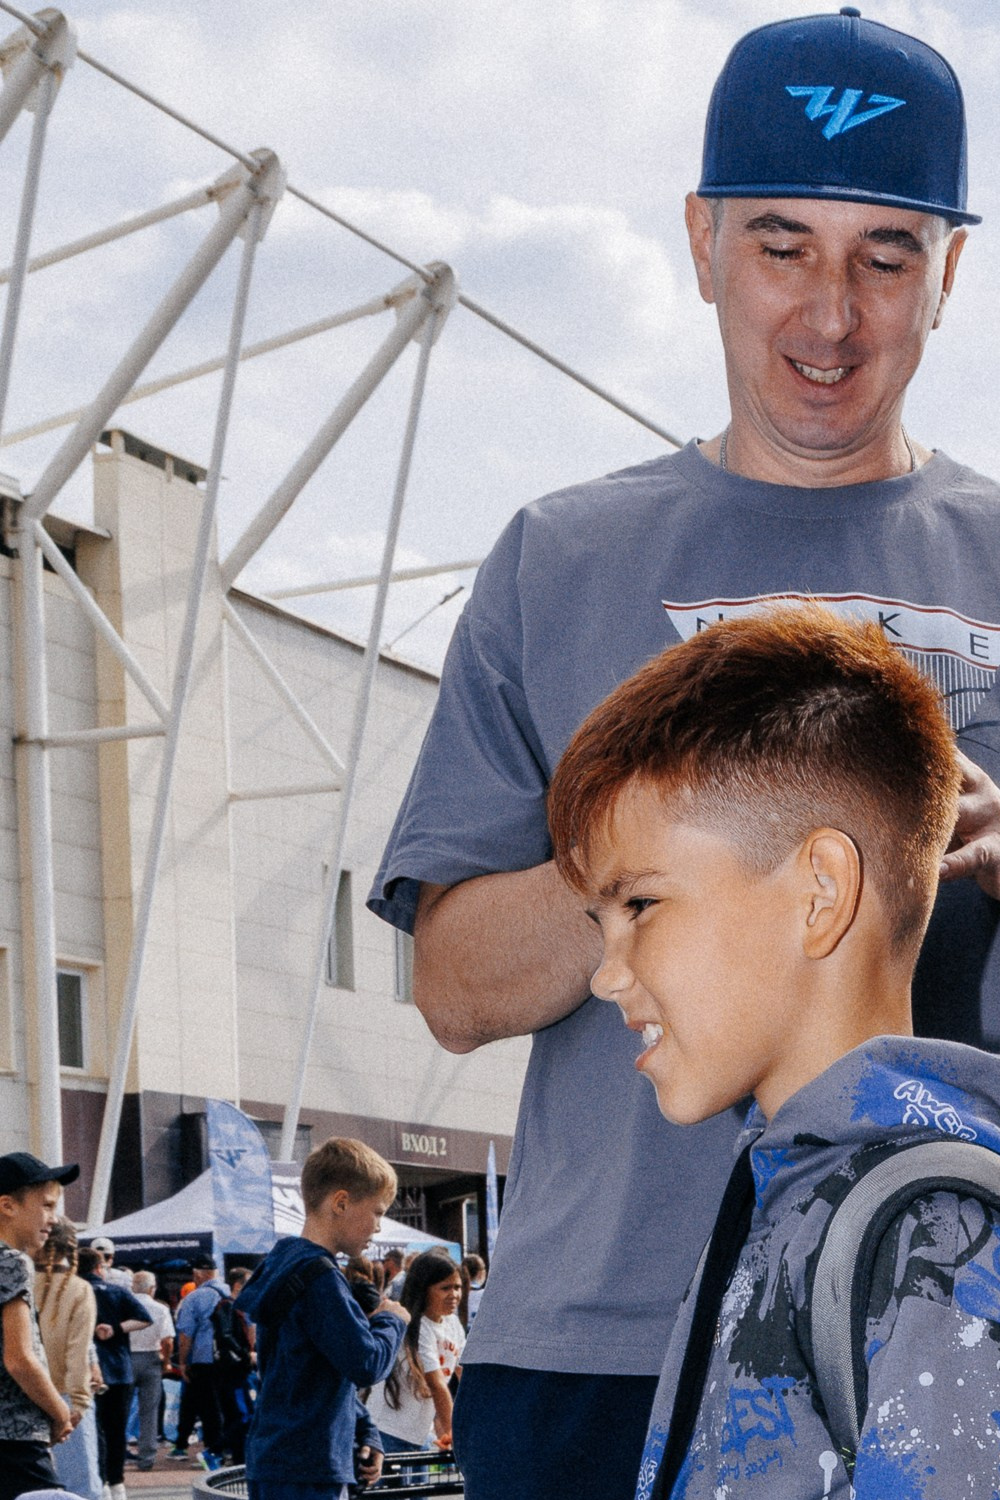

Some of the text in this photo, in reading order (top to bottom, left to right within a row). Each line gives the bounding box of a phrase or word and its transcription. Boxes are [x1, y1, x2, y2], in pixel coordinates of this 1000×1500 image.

[697, 611, 990, 659] NKE
[402, 1132, 448, 1157] ВХОД 2
